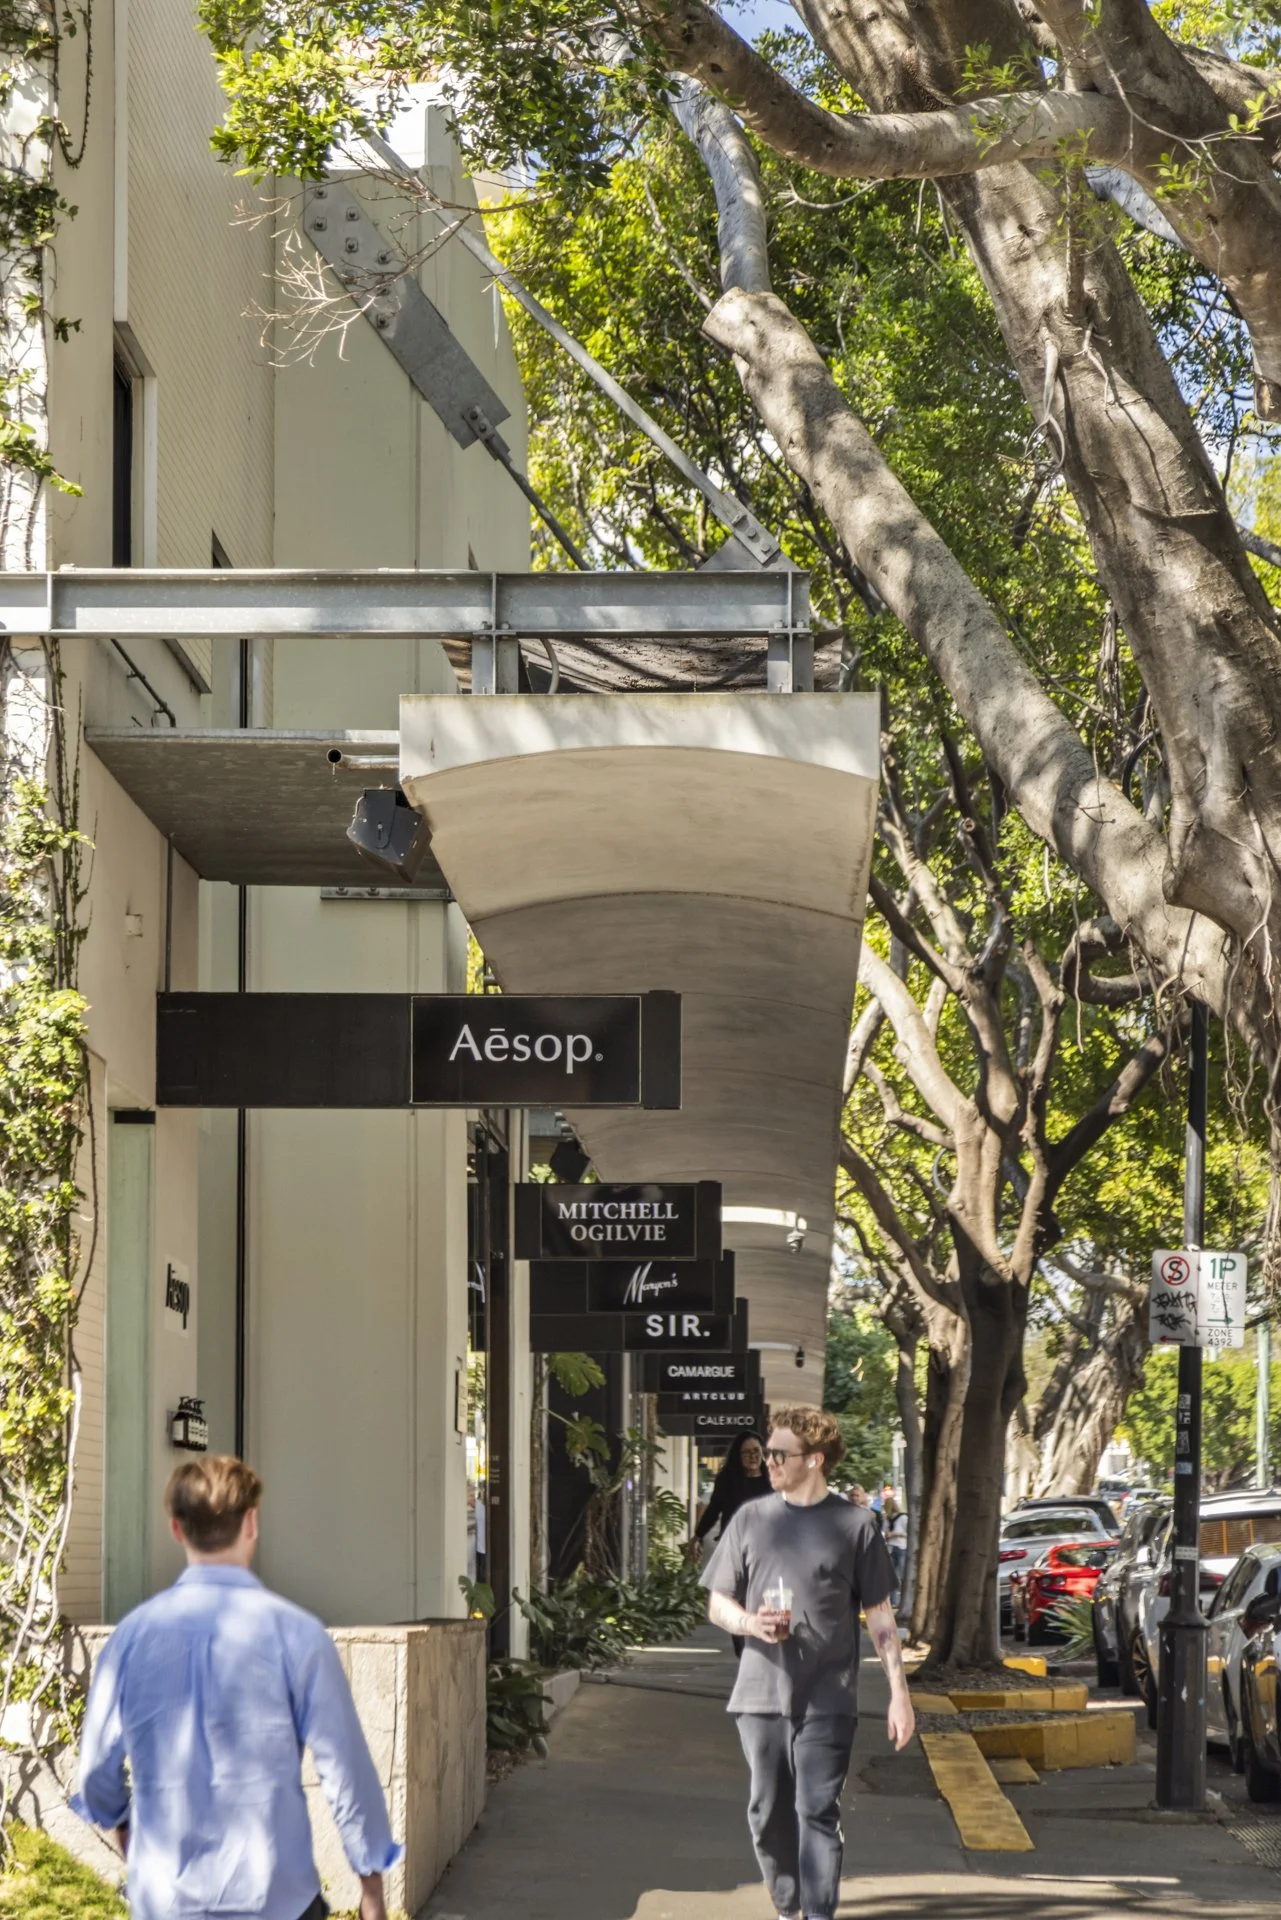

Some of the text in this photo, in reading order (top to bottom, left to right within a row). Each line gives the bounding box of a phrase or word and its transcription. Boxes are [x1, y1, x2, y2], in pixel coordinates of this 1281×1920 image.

[558, 1202, 679, 1220] MITCHELL
[570, 1224, 667, 1241] OGILVIE
[1210, 1258, 1237, 1279] 1P
[645, 1314, 711, 1337] SIR.
[1208, 1329, 1233, 1337] ZONE
[1208, 1338, 1233, 1347] 4392
[667, 1365, 735, 1378] CAMARGUE
[682, 1392, 745, 1401] ARTCLUB
[696, 1415, 755, 1426] CALEXICO
